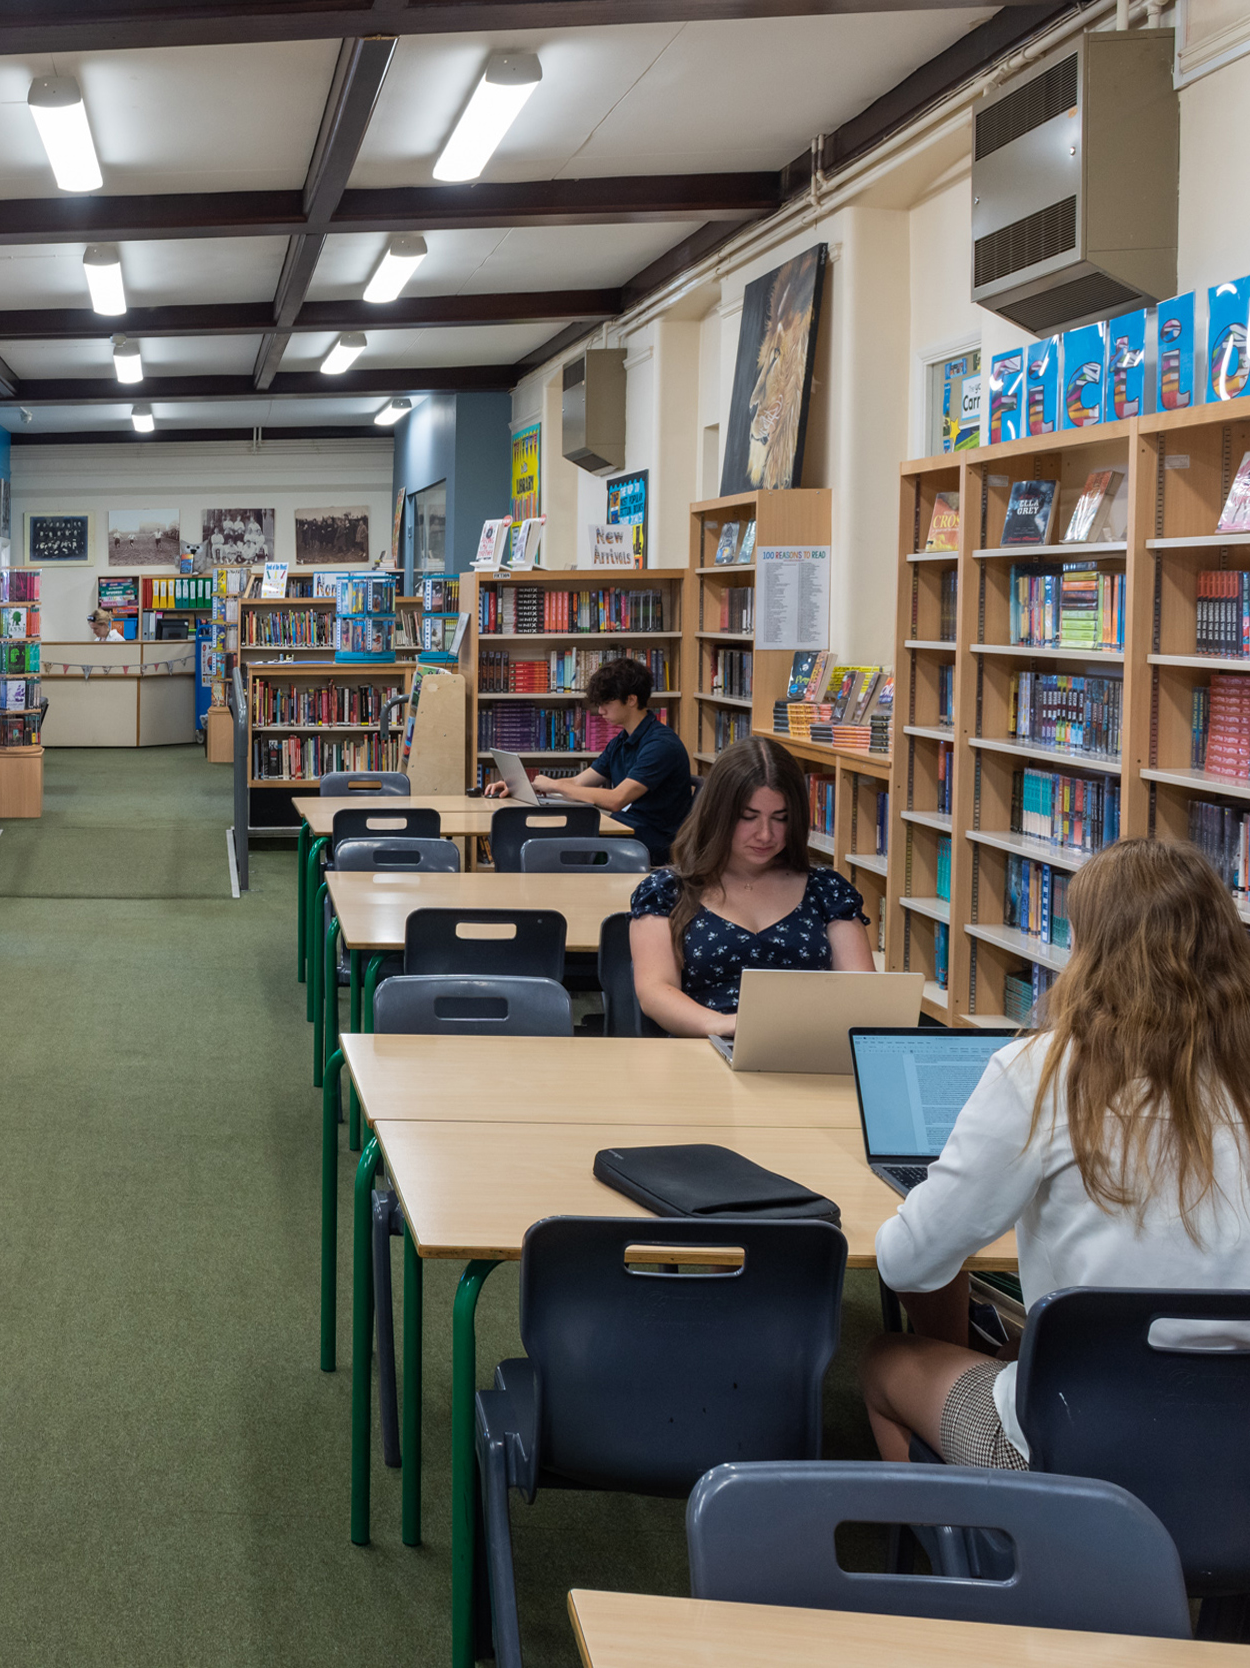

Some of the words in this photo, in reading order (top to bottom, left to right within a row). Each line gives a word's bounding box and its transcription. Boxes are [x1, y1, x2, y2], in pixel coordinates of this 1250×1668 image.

[990, 318, 1250, 445] Fictio
[1017, 507, 1039, 515] GREY
[596, 527, 624, 544] New
[594, 545, 631, 565] Arrivals
[775, 551, 802, 559] REASONS
[803, 551, 810, 559] TO
